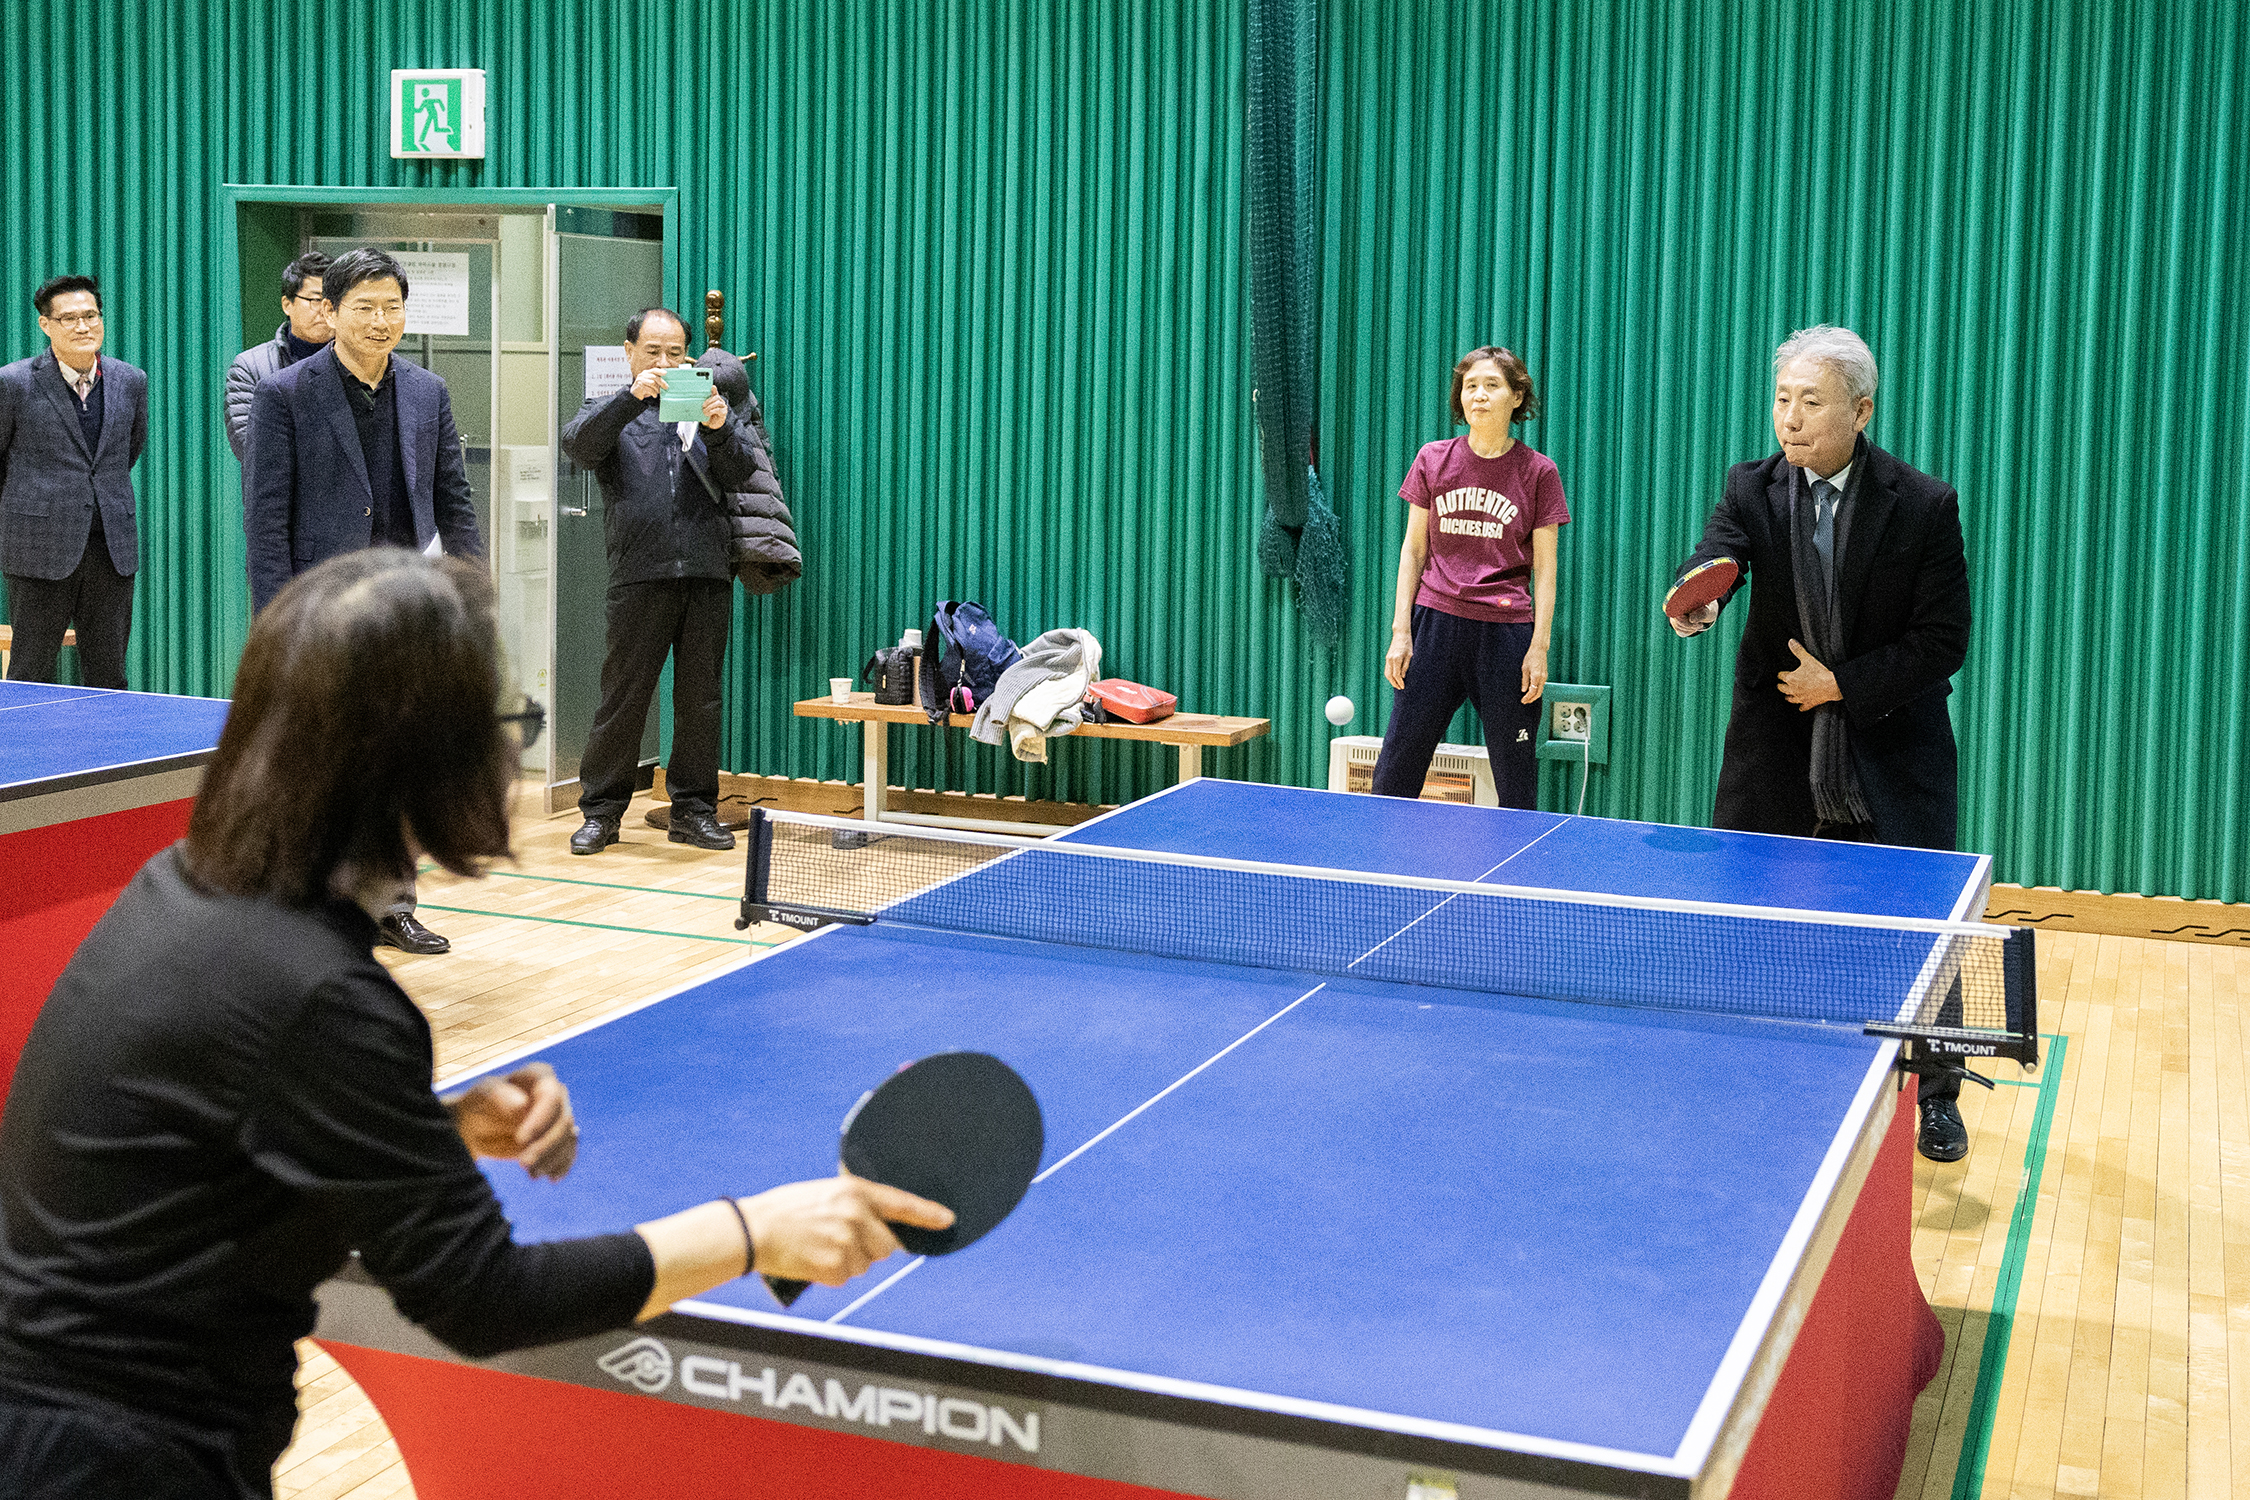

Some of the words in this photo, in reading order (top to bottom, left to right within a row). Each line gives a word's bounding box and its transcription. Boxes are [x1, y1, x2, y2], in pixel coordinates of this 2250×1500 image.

[1435, 487, 1519, 525] AUTHENTIC
[780, 912, 820, 926] TMOUNT
[1943, 1041, 1997, 1056] TMOUNT
[679, 1354, 1041, 1453] CHAMPION
